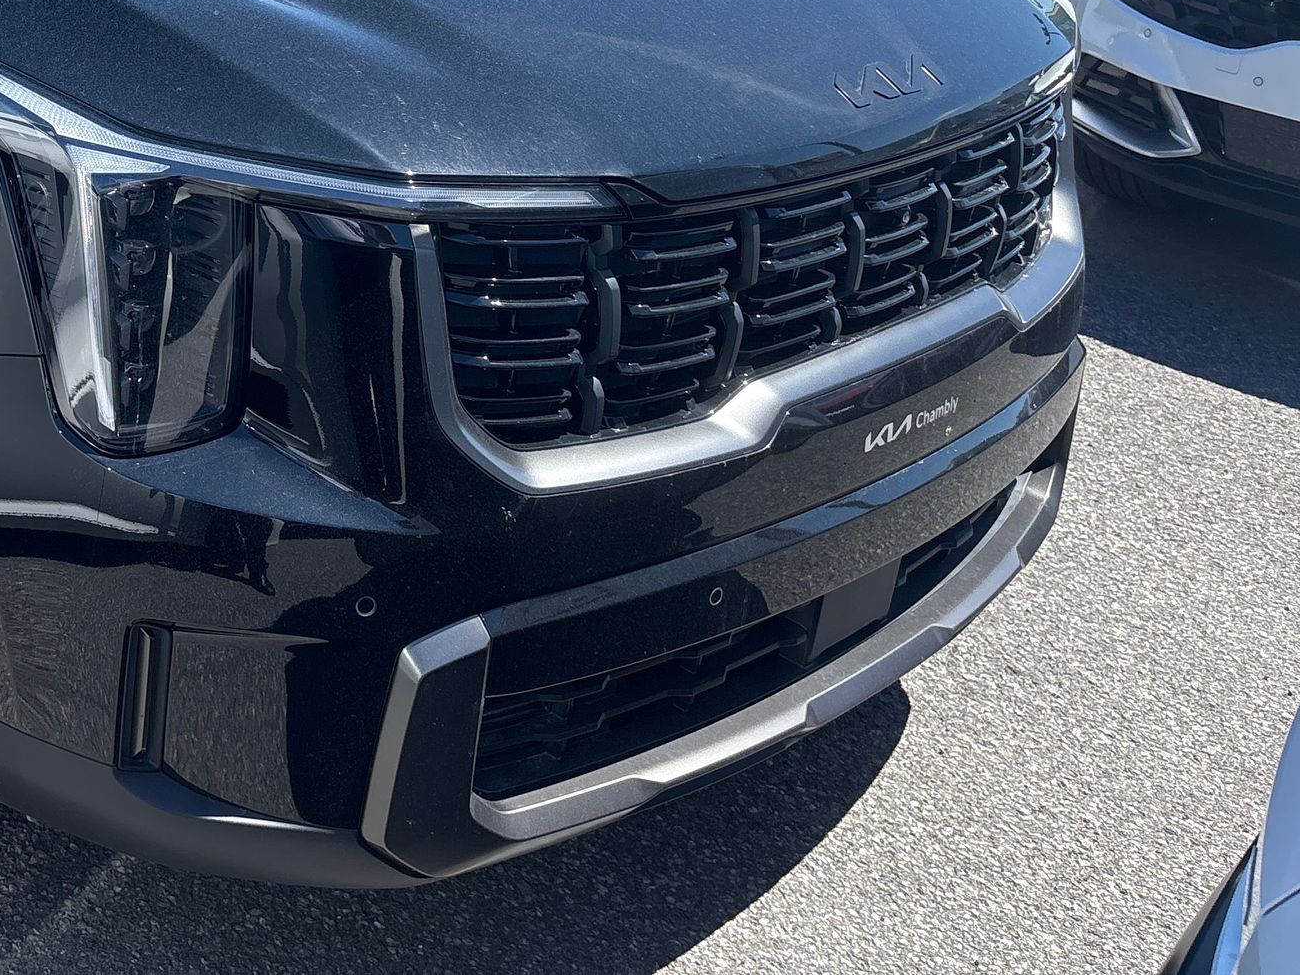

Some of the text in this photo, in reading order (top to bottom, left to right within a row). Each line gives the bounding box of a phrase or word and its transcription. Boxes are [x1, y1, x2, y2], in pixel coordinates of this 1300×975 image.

[833, 53, 944, 109] KIA
[864, 396, 959, 453] KIA Chambly
